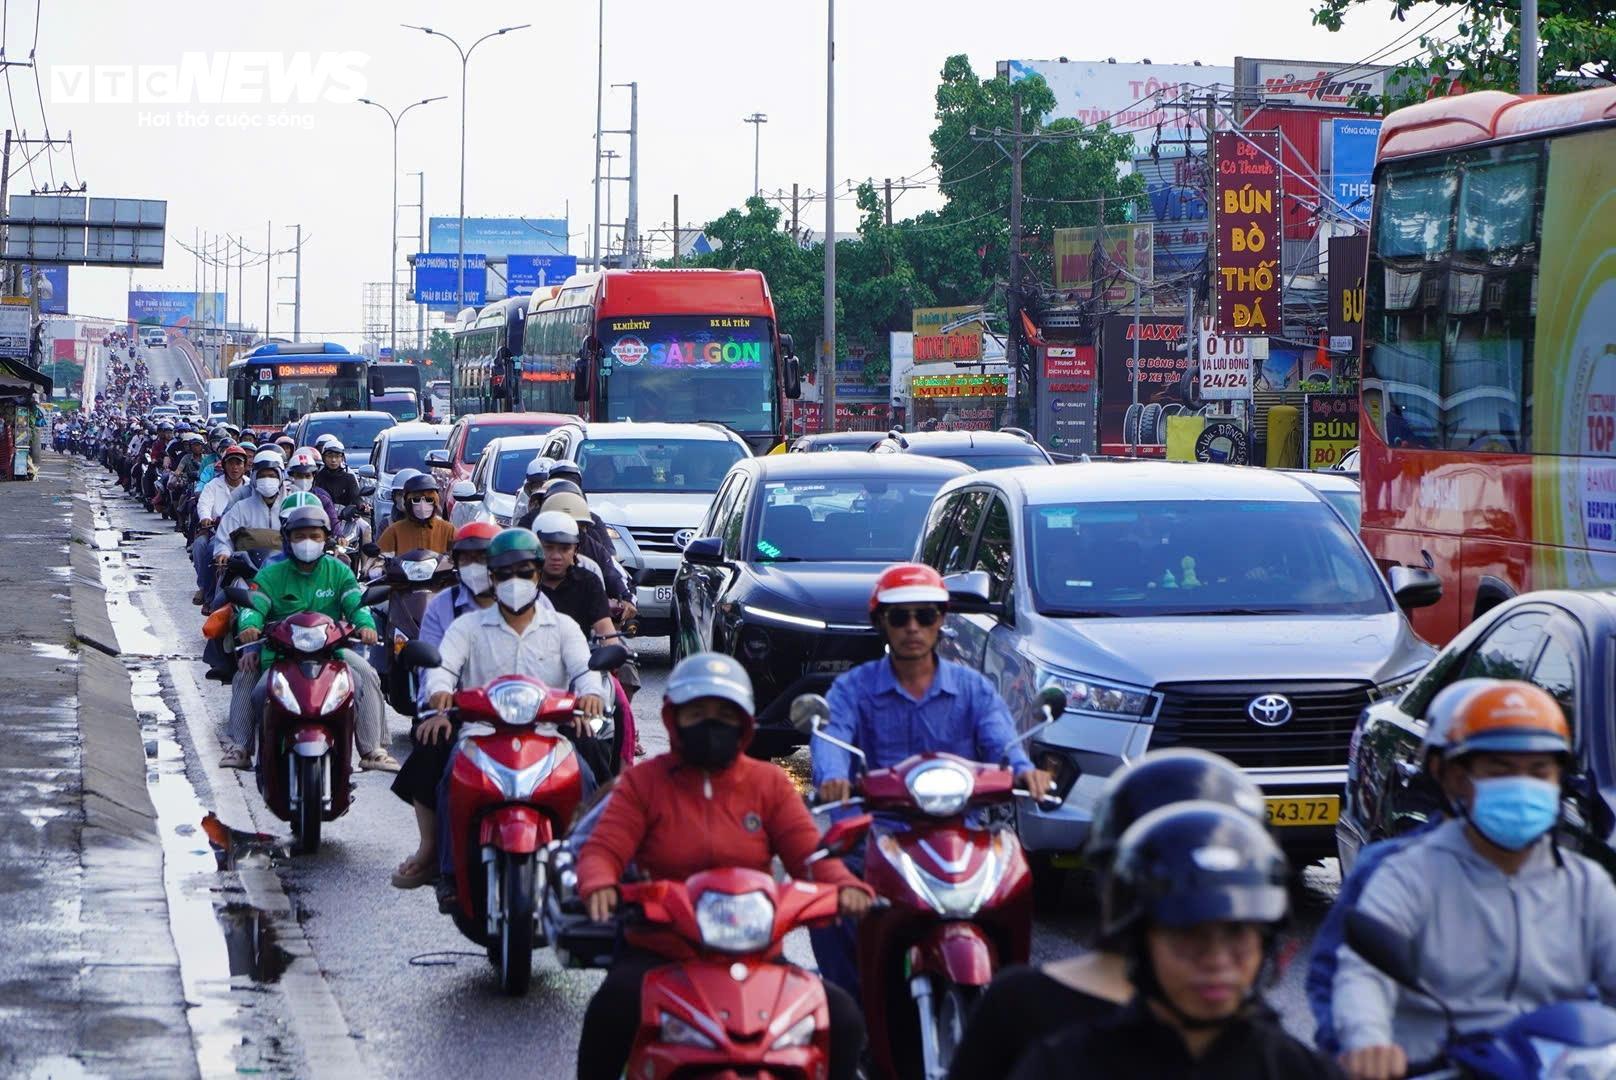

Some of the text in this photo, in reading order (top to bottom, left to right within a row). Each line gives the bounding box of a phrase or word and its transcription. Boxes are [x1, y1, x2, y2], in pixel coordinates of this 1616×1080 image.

[1237, 161, 1274, 175] Thanh
[1224, 183, 1272, 214] BÚN
[1231, 221, 1266, 252] BÒ
[1342, 277, 1363, 323] BÚ
[1233, 297, 1267, 328] ĐÁ
[651, 336, 761, 364] SÀI GÒN
[1207, 333, 1217, 355] Ô
[1213, 357, 1227, 370] LƯU
[1229, 356, 1249, 372] ĐỘNG
[261, 370, 271, 379] 09
[1203, 373, 1248, 388] 24/24
[920, 386, 960, 395] MINH
[1313, 418, 1356, 438] BÚN
[1587, 415, 1615, 452] TOP
[1314, 443, 1336, 463] BÒ
[316, 589, 335, 598] Grab
